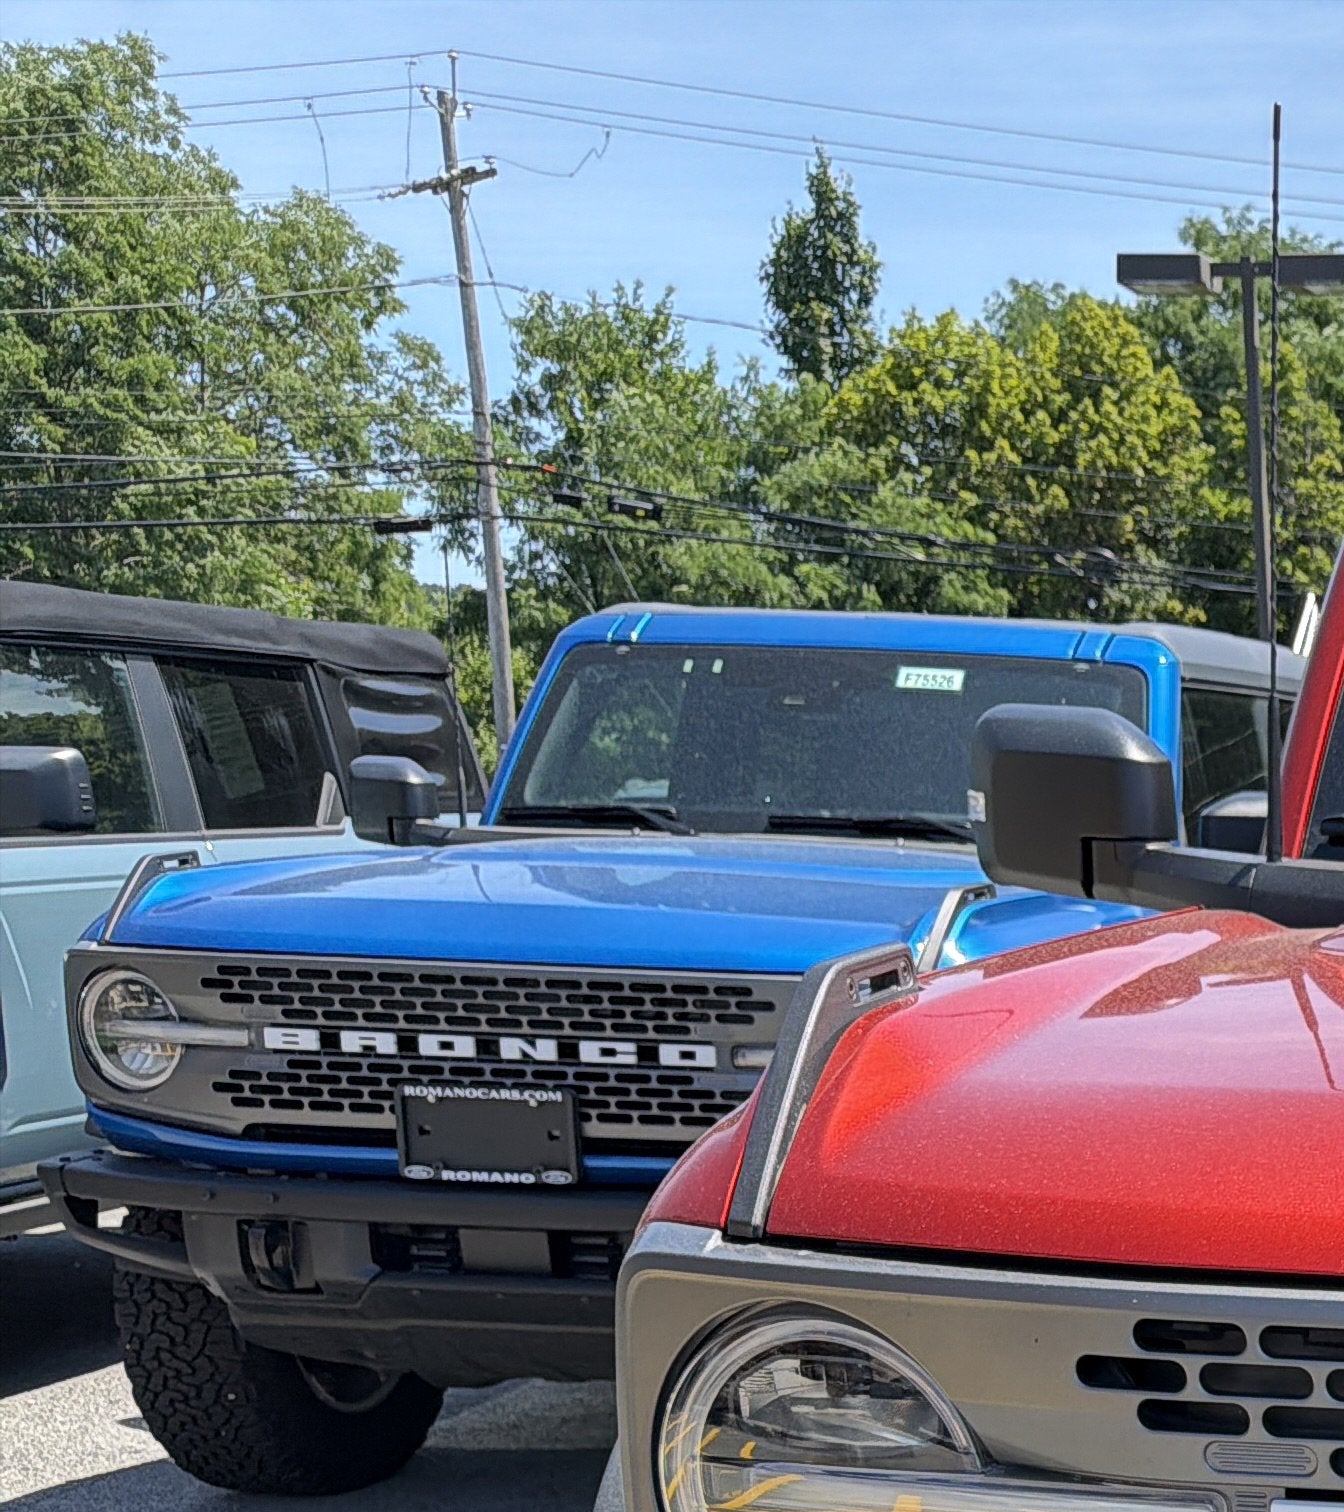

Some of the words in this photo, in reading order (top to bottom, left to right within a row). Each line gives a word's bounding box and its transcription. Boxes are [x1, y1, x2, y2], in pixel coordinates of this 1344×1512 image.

[904, 672, 955, 689] F75526
[264, 1025, 718, 1068] BRONCO
[403, 1085, 563, 1103] ROMANOCARS.COM
[441, 1169, 536, 1185] ROMANO
